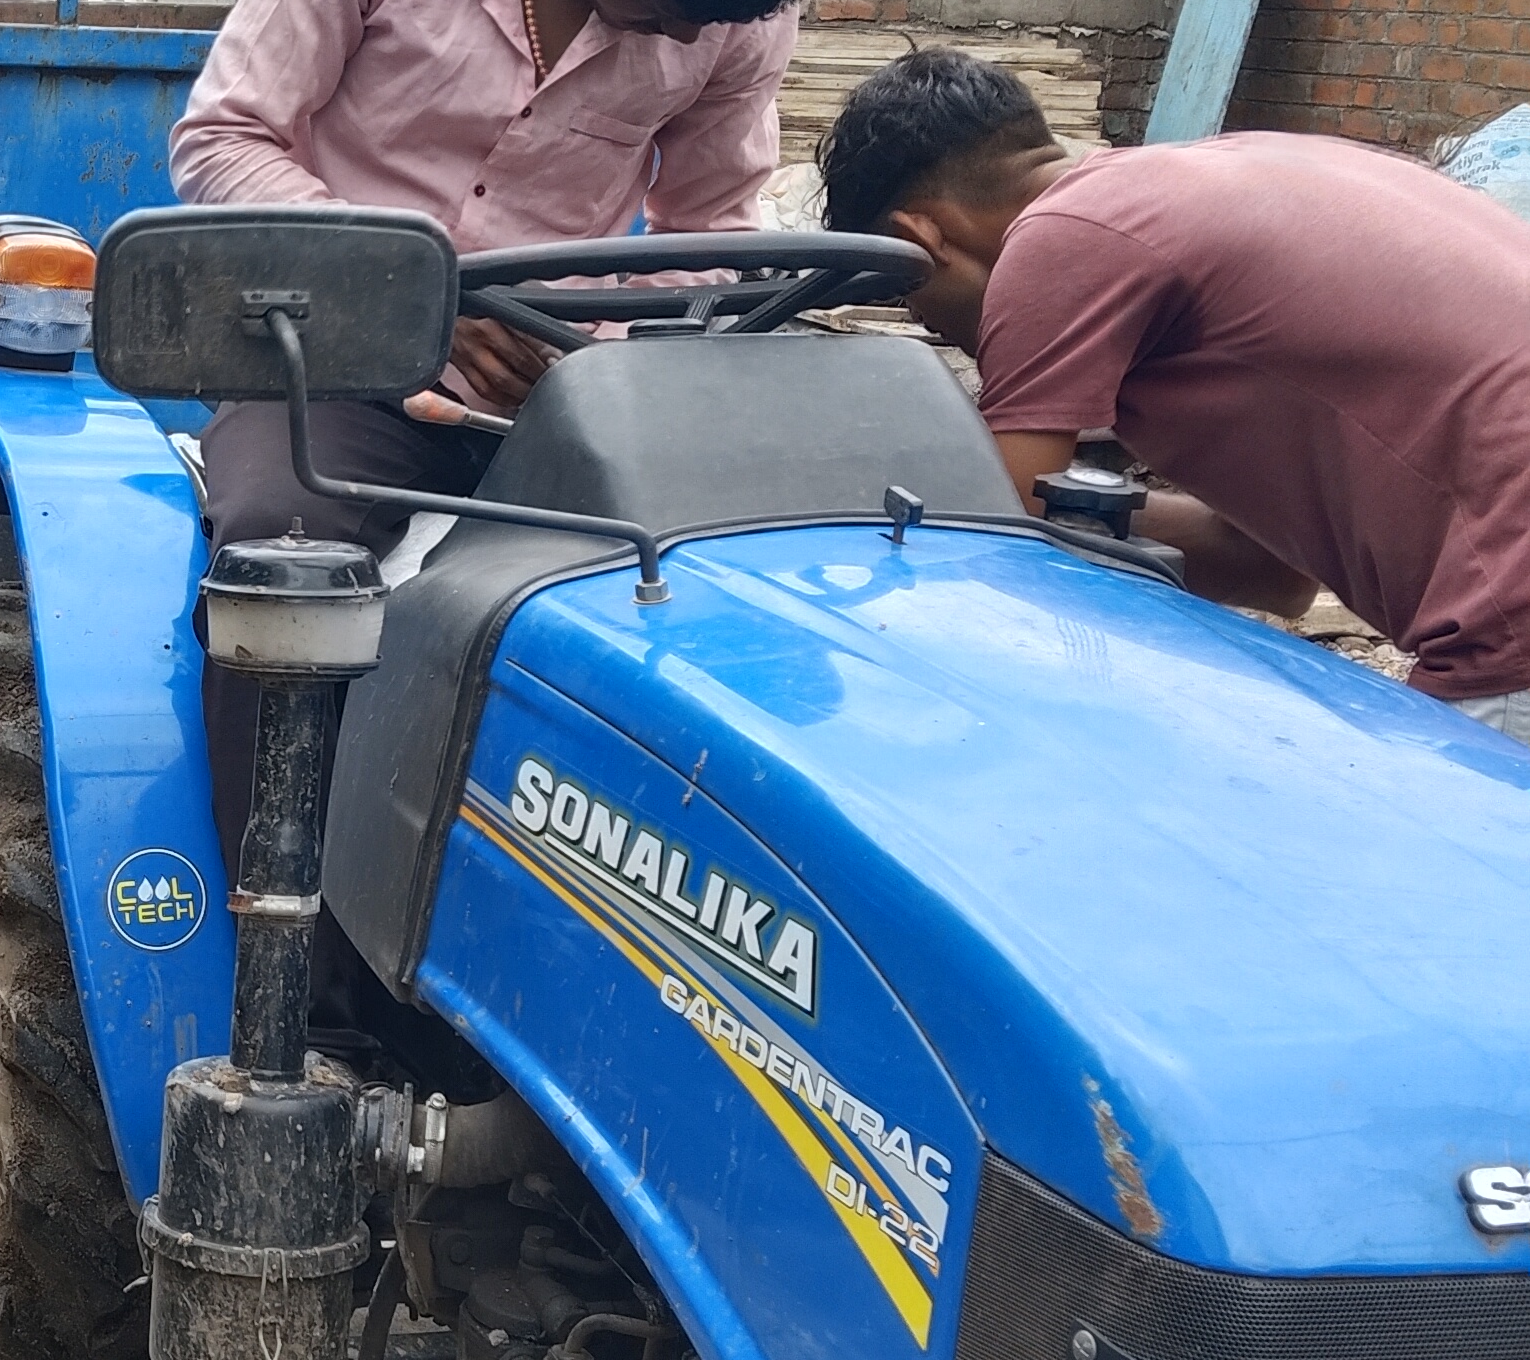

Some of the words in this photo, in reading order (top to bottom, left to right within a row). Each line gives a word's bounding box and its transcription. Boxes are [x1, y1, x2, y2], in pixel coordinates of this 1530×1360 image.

[117, 900, 195, 926] TECH
[511, 757, 817, 1014] SONALIKA
[659, 973, 952, 1193] GARDENTRAC
[824, 1160, 942, 1266] DI-22
[1458, 1164, 1530, 1236] S
